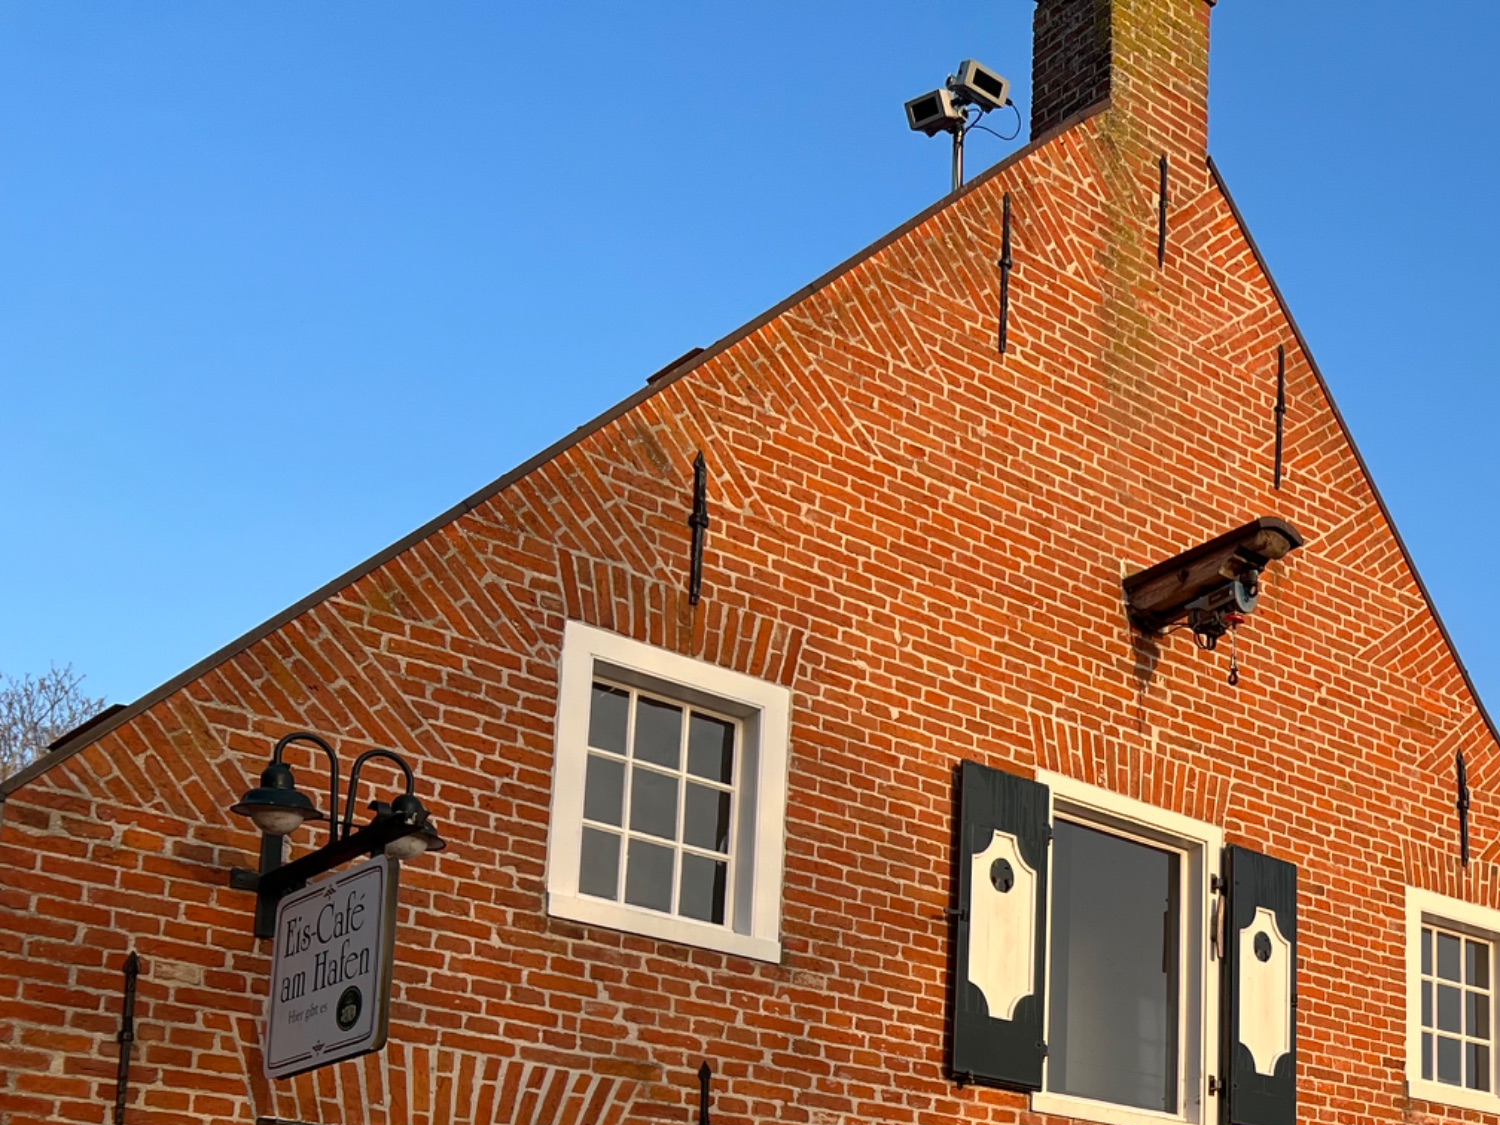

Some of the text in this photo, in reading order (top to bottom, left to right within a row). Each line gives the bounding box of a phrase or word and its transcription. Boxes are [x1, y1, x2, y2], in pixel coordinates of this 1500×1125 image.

[284, 891, 365, 959] Eis-Café
[280, 939, 370, 1003] am Hafen
[288, 1002, 328, 1024] Hier gibt es
